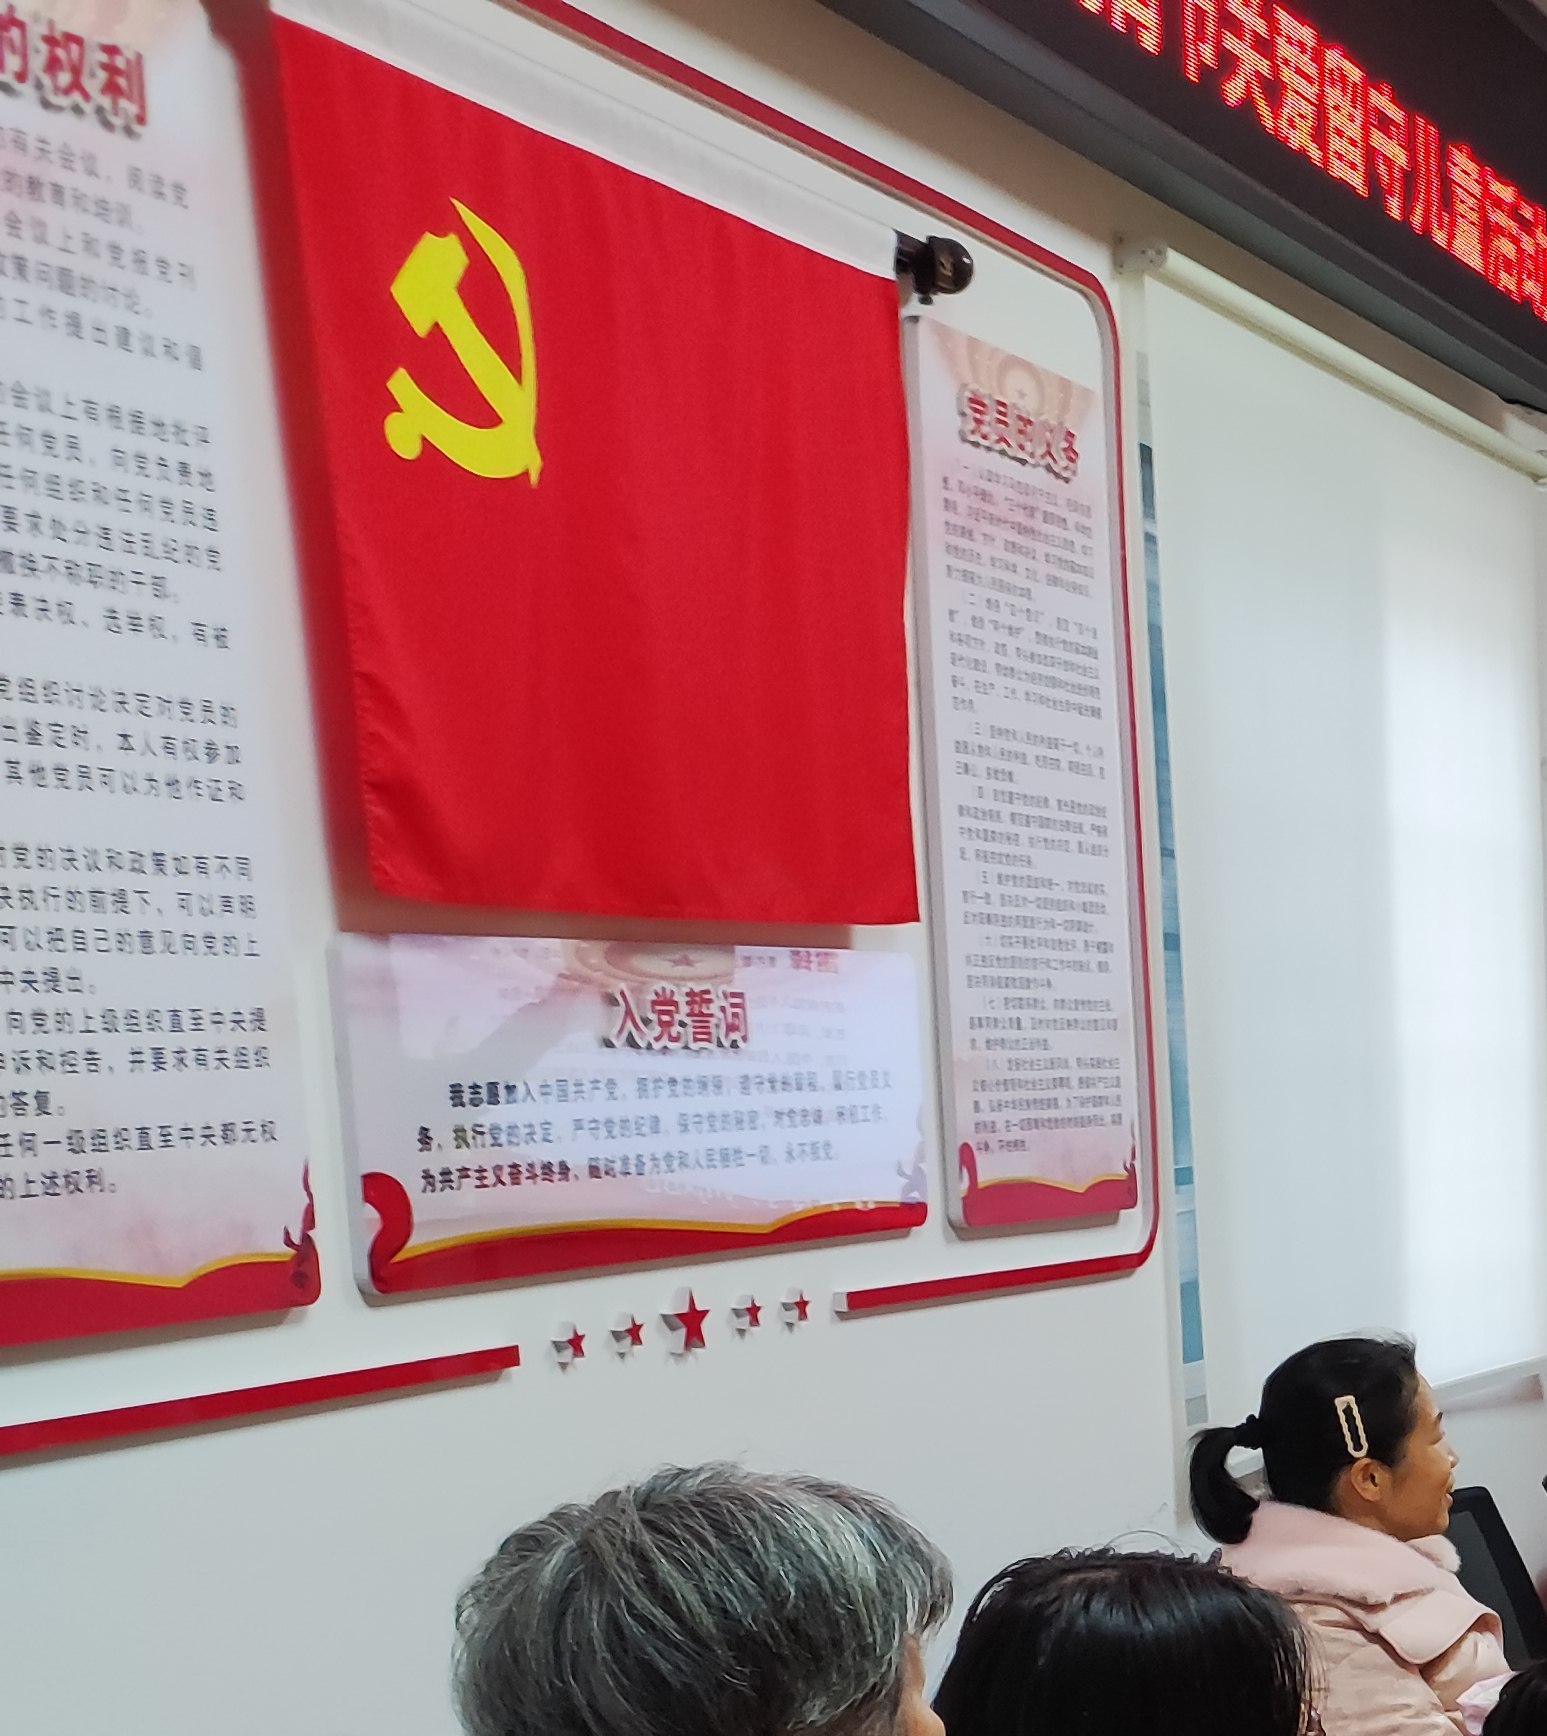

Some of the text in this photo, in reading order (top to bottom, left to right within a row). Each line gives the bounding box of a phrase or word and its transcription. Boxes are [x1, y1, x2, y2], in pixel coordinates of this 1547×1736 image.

[614, 988, 750, 1047] 入党誓词
[0, 1088, 65, 1118] 答复。
